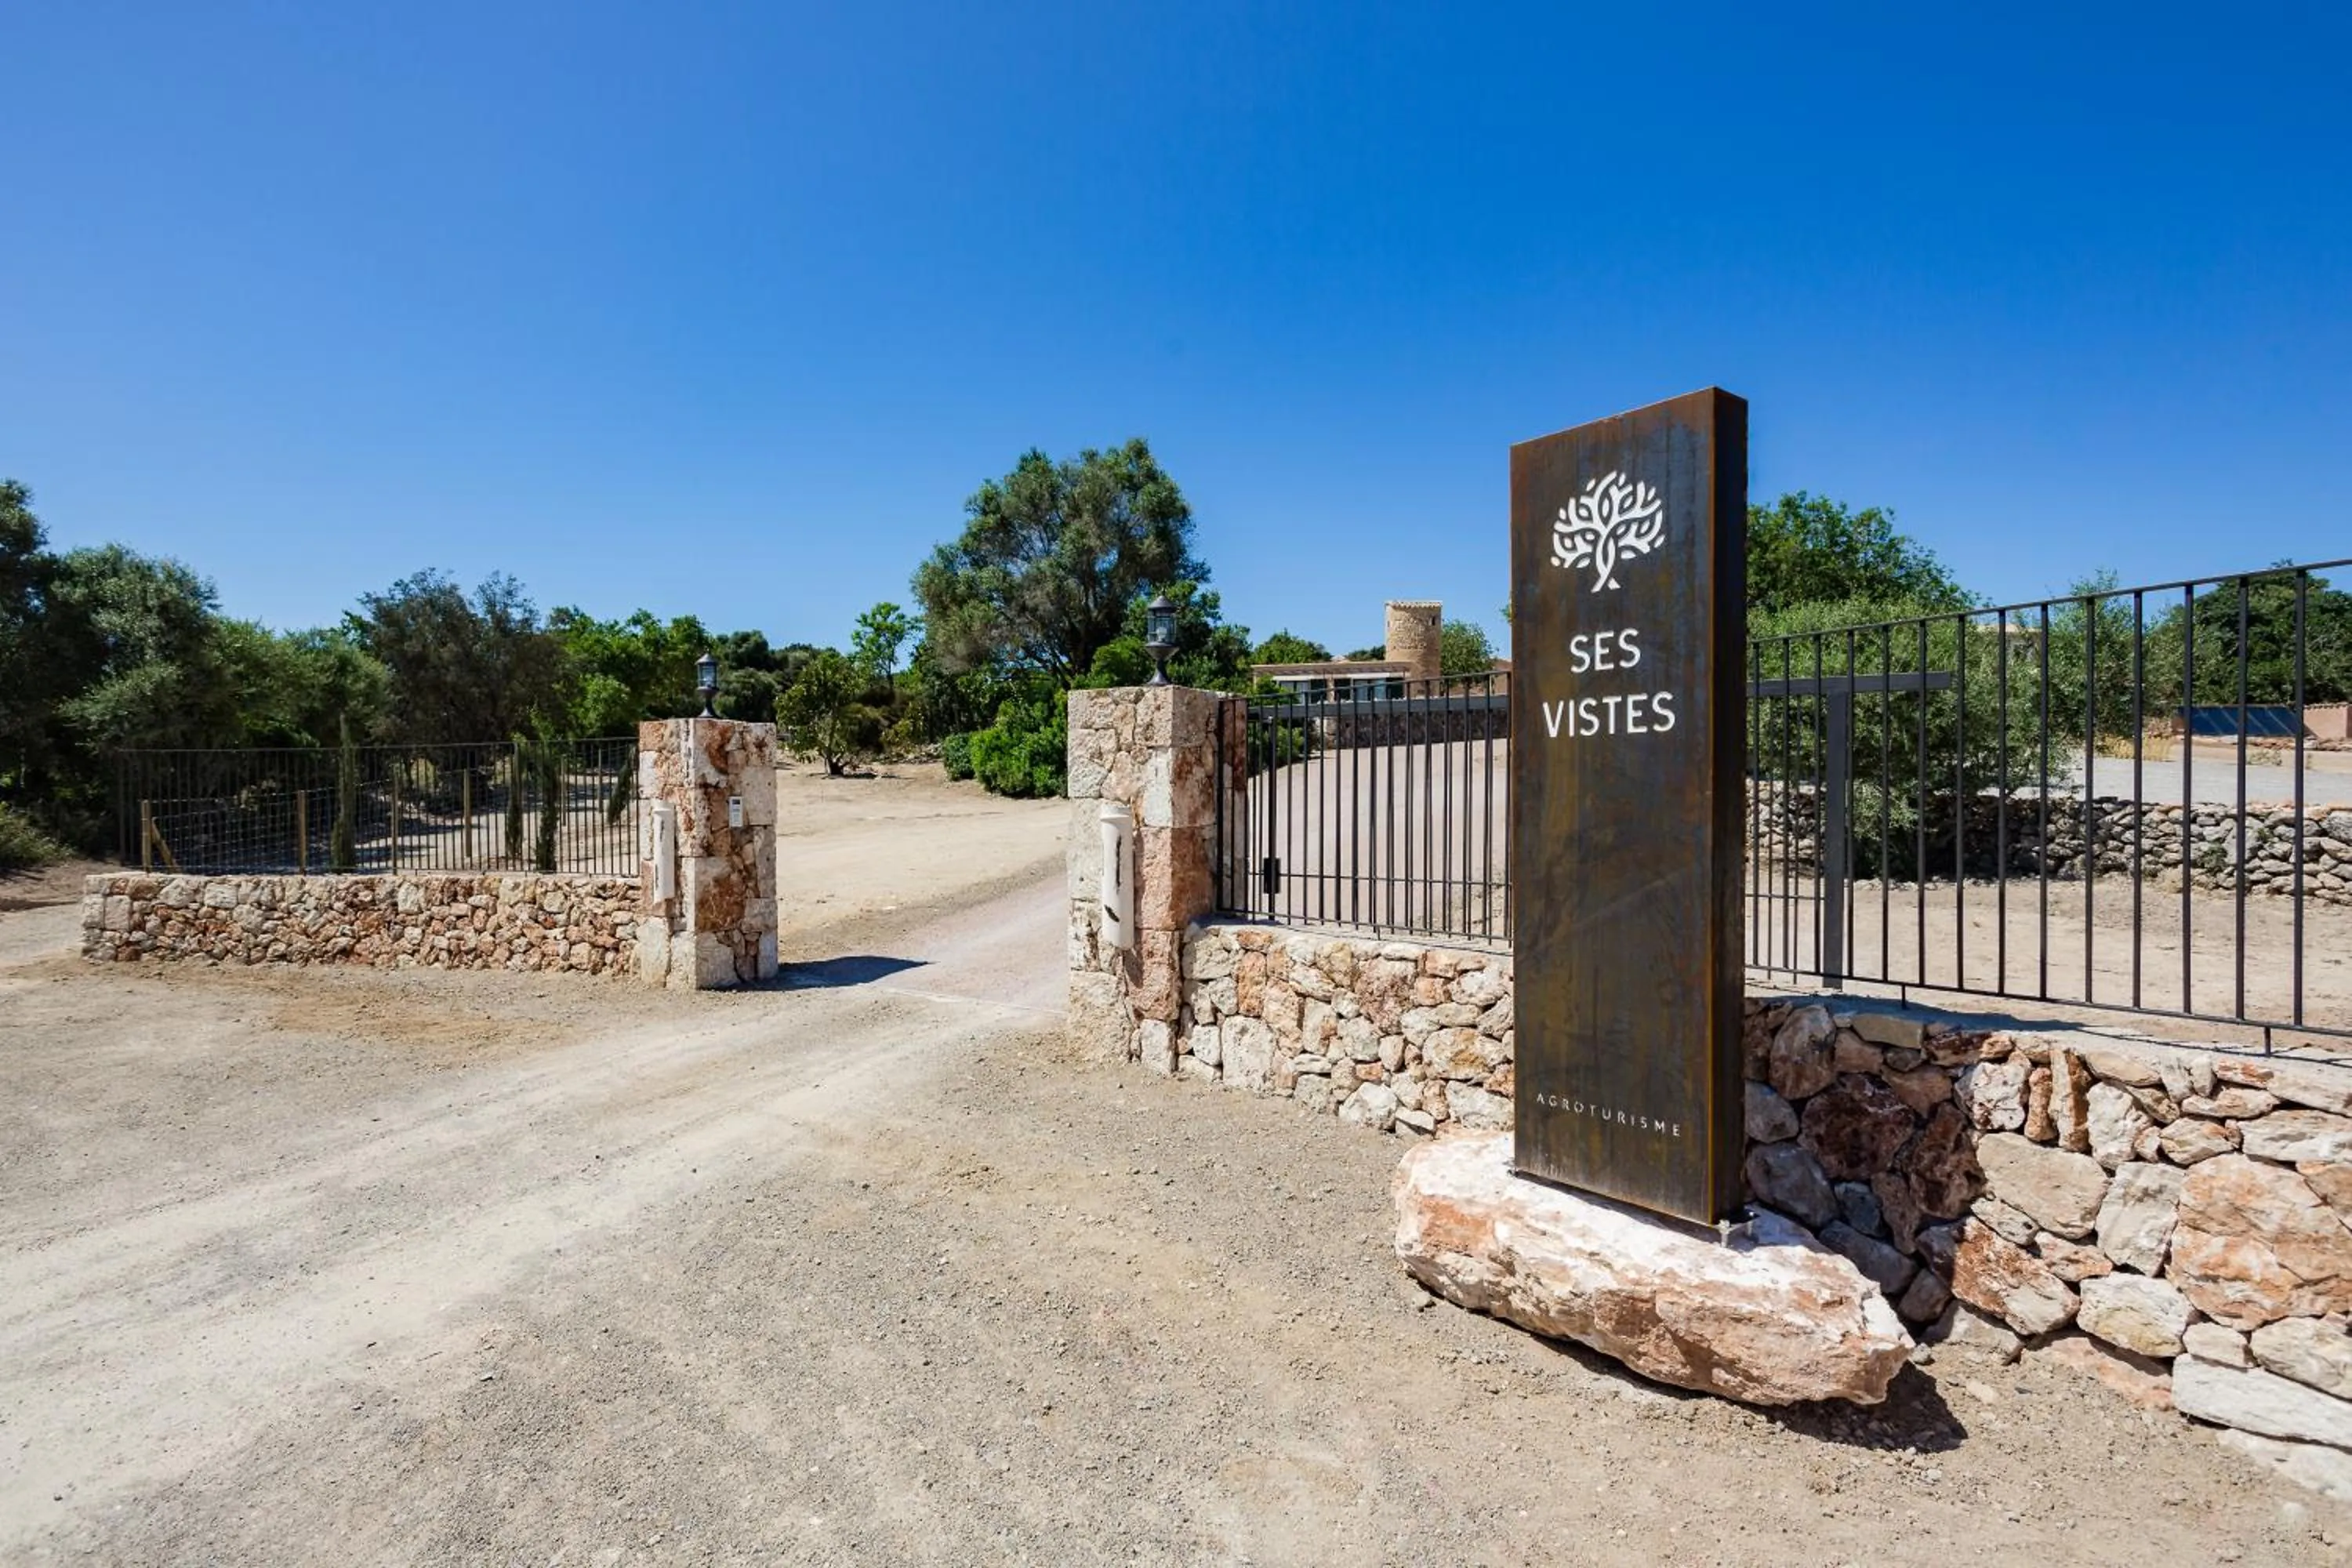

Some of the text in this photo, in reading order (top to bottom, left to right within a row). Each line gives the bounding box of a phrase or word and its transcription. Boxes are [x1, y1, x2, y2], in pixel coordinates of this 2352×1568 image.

[1570, 628, 1641, 673] SES
[1542, 691, 1675, 738] VISTES
[1536, 1093, 1681, 1137] AGROTURISME
